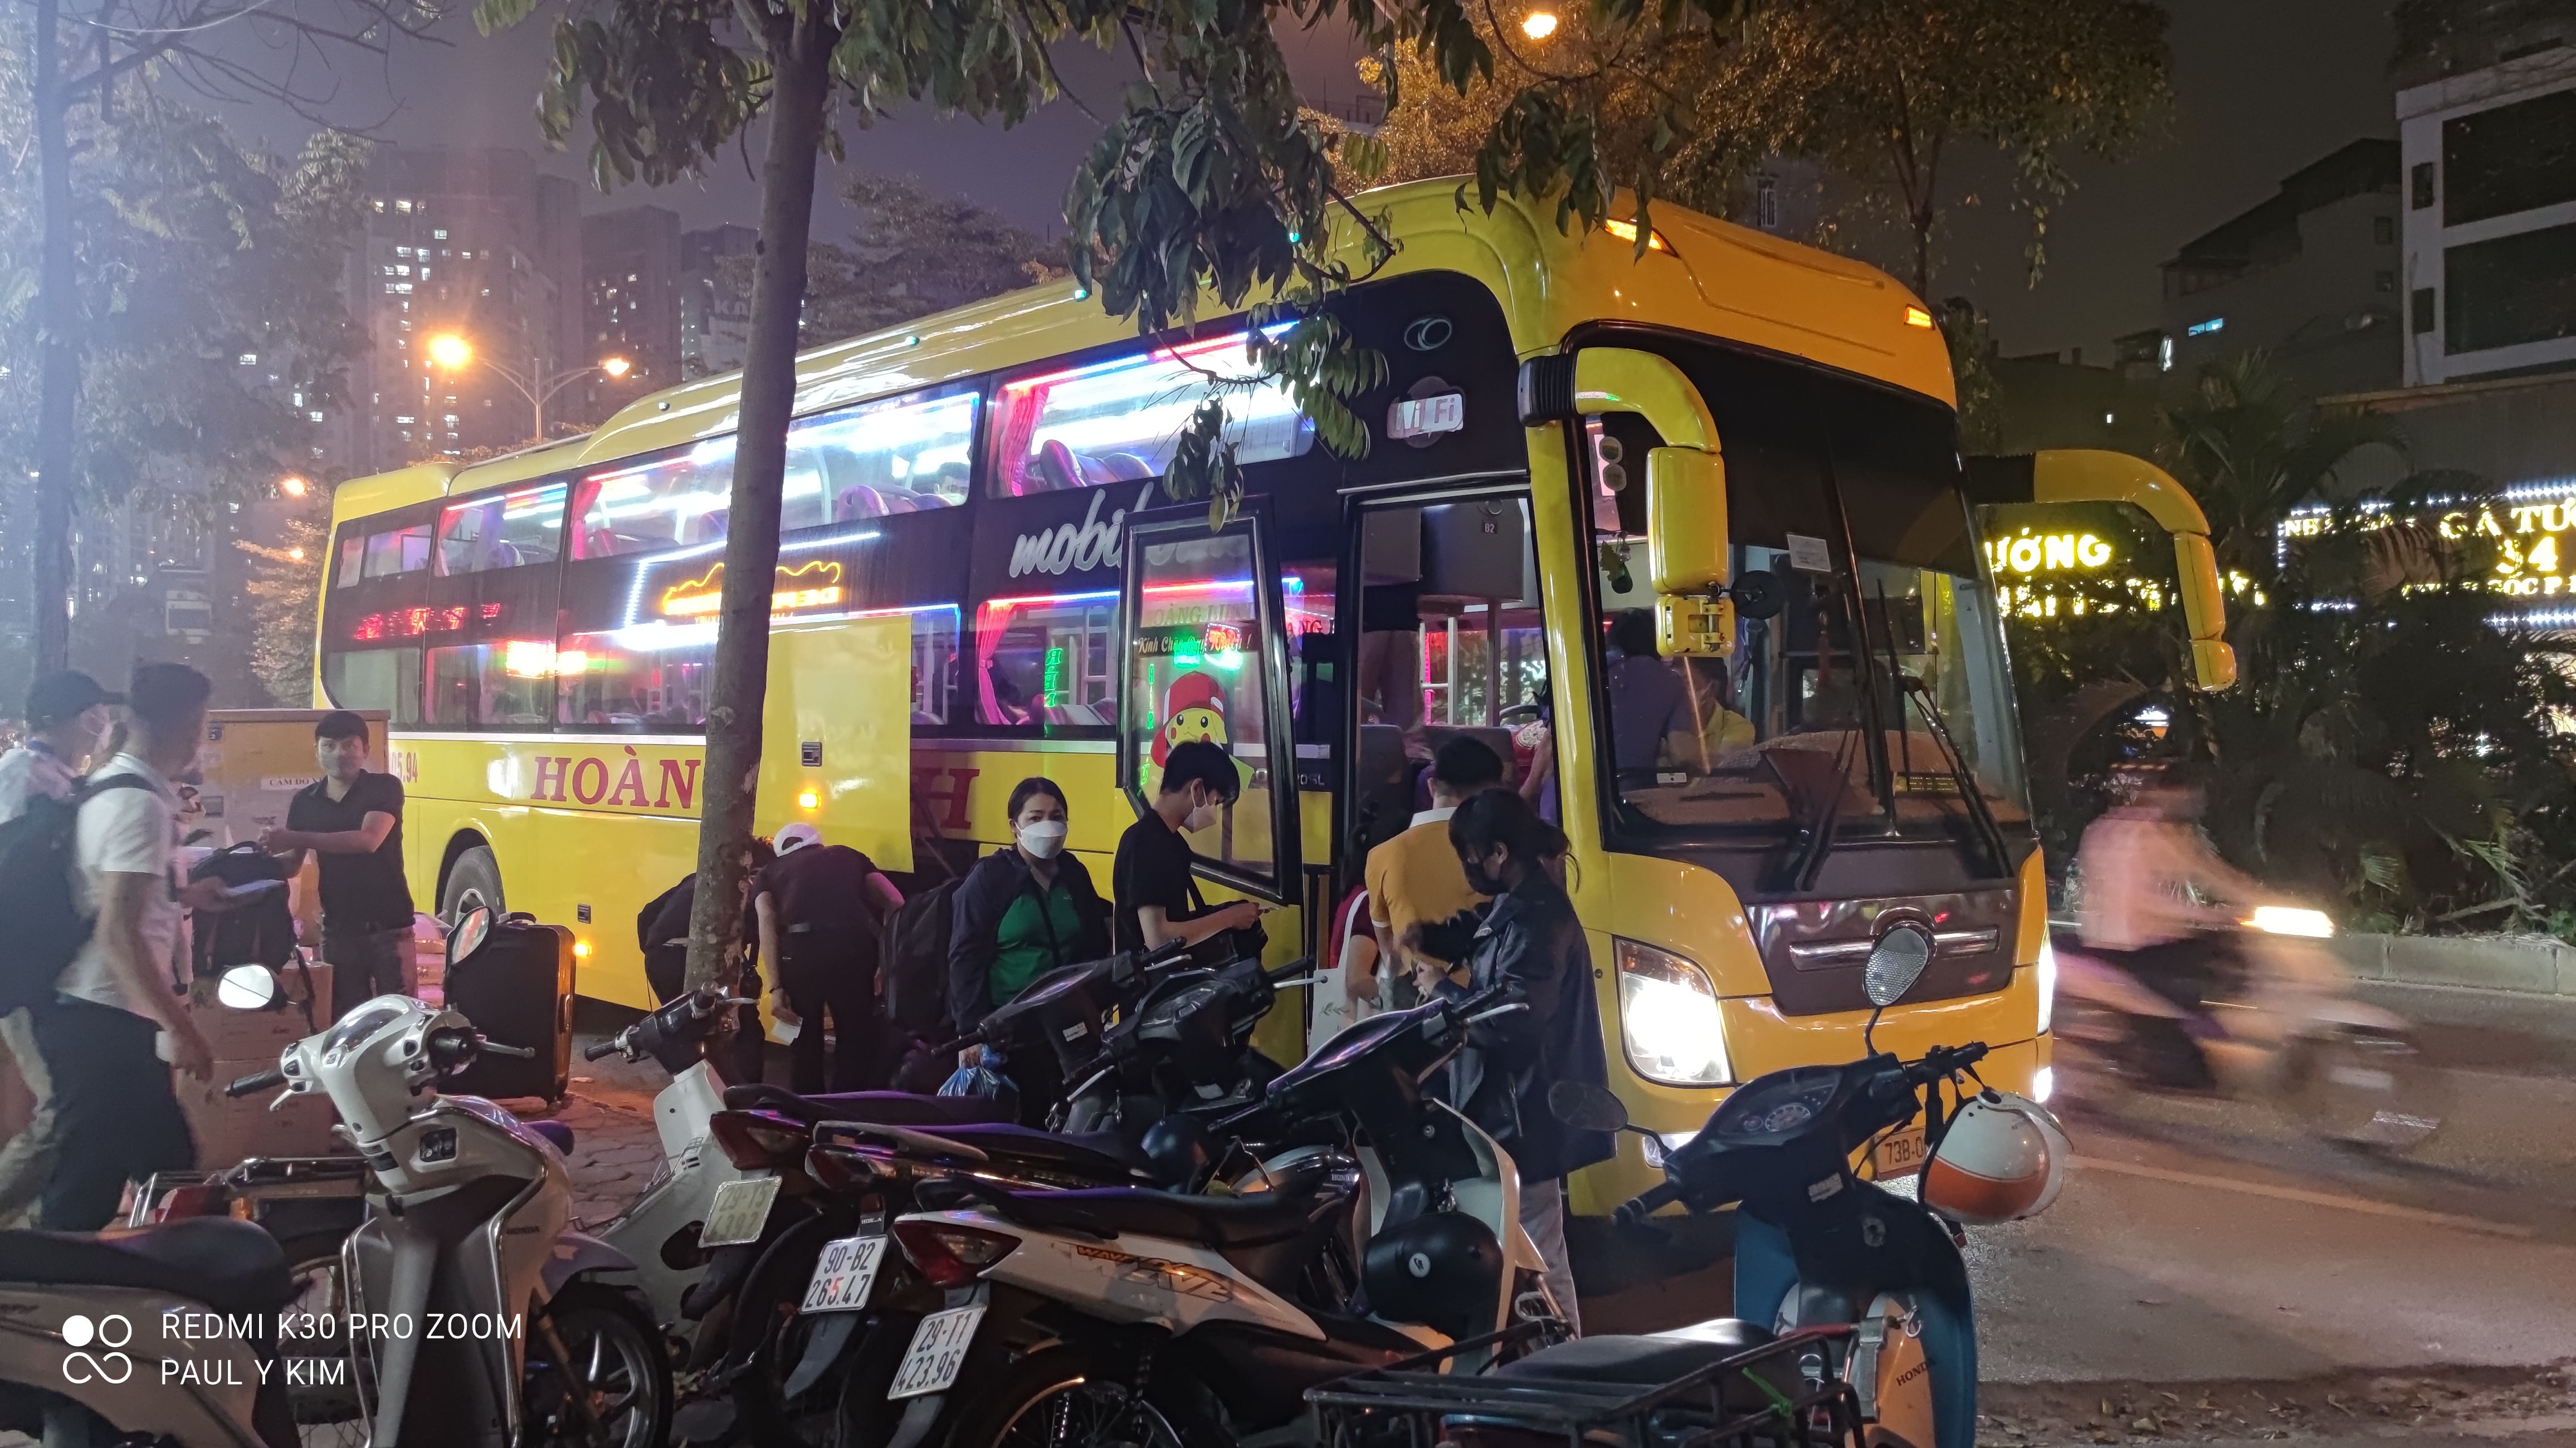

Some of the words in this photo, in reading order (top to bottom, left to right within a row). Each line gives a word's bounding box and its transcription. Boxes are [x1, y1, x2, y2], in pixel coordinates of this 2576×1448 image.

[823, 1241, 876, 1274] 90-B2
[804, 1274, 871, 1308] 265.47
[916, 1312, 973, 1353] 29-T1
[897, 1348, 961, 1392] 423.96
